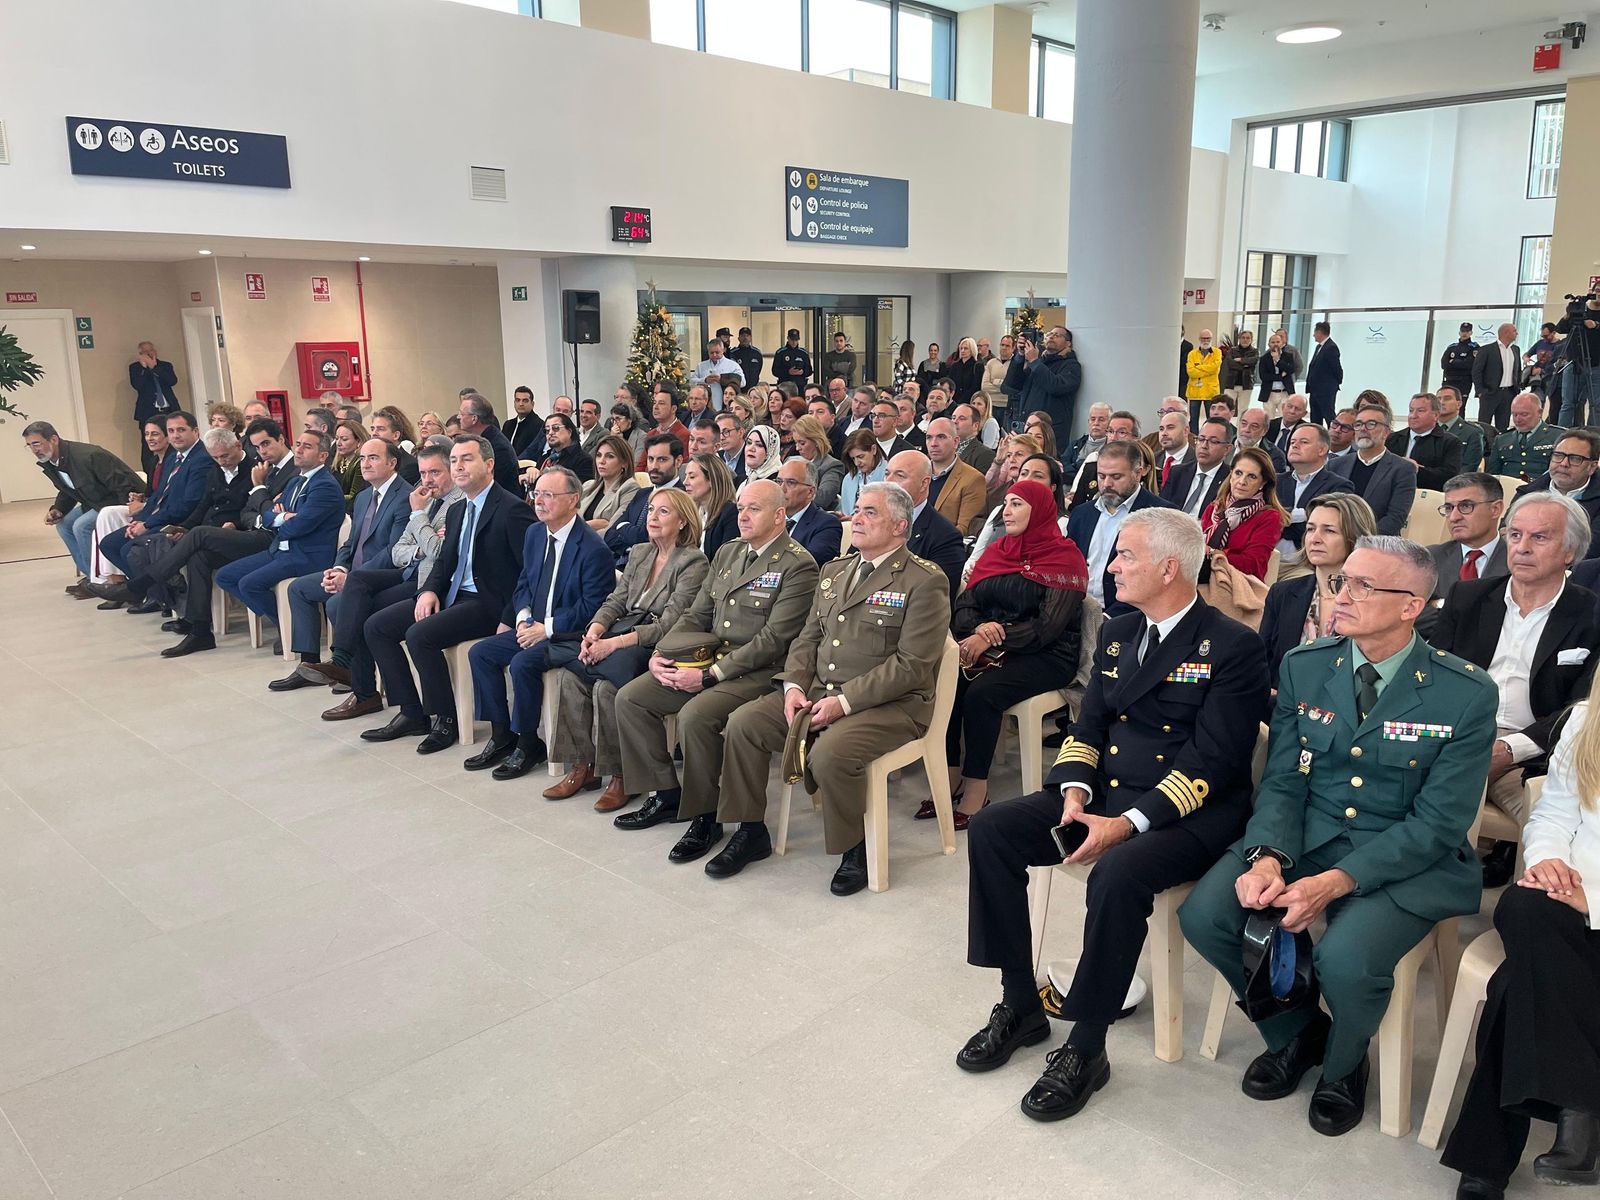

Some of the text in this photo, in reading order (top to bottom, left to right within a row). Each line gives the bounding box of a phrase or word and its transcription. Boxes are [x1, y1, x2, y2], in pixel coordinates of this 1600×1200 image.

[171, 129, 239, 154] Aseos
[173, 162, 226, 177] TOILETS
[820, 173, 869, 188] Sala de embarque
[820, 197, 841, 207] Control
[842, 199, 850, 208] de
[631, 226, 645, 238] 64
[820, 221, 874, 235] Control de equipaje
